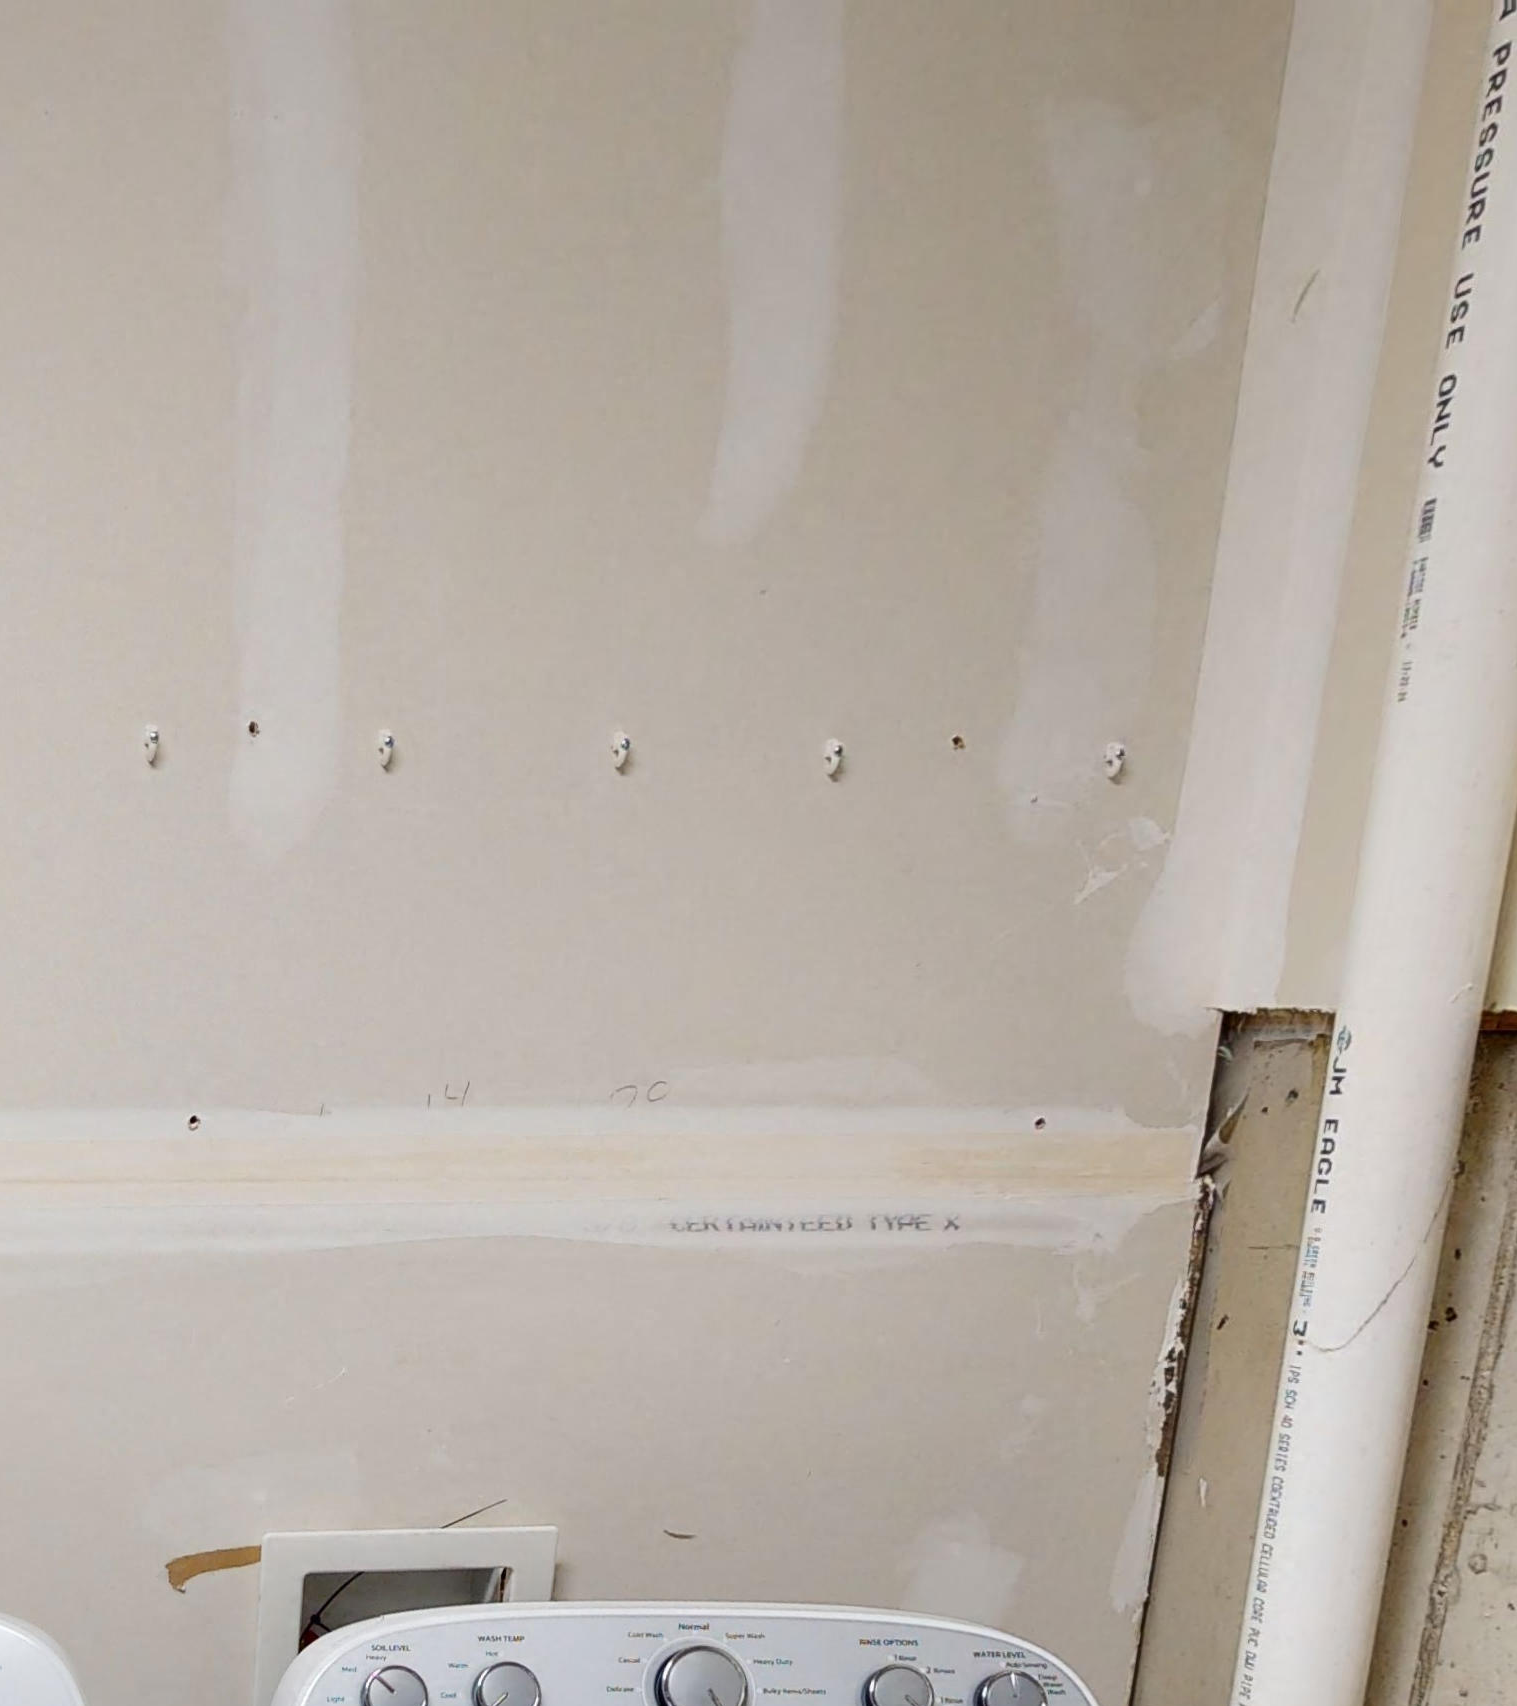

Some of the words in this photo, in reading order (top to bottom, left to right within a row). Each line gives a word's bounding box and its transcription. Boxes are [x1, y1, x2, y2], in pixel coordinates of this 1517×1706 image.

[1462, 41, 1512, 250] PRESSURE
[1445, 273, 1474, 349] USE
[1427, 374, 1457, 469] ONLY
[1329, 1057, 1347, 1095] JM
[1310, 1119, 1339, 1214] EAGLE
[870, 1213, 933, 1232] TYPE
[942, 1214, 961, 1231] X
[678, 1623, 710, 1631] Normal
[883, 1639, 919, 1647] OPTIONS
